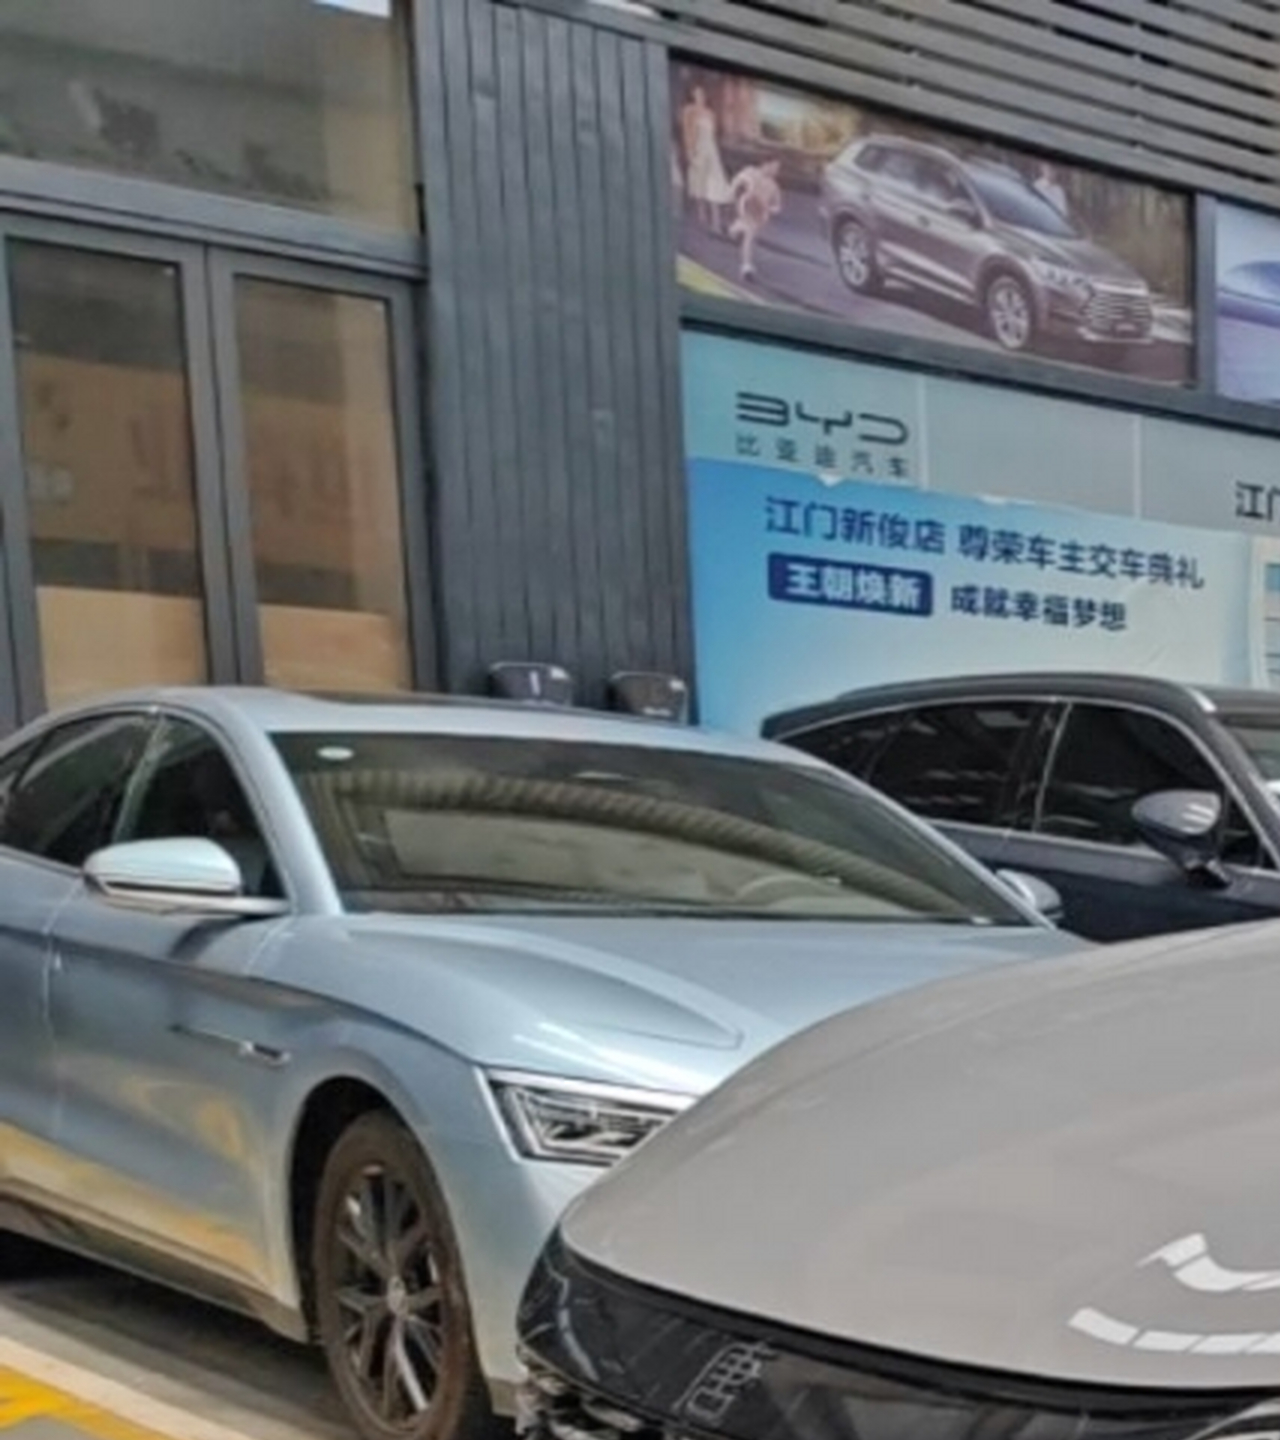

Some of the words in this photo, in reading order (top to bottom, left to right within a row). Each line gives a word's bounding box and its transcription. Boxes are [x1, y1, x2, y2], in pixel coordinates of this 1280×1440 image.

[736, 391, 908, 446] BYD
[766, 496, 944, 553] 江门新俊店
[959, 523, 1204, 590] 尊荣车主交车典礼
[951, 585, 1127, 632] 成就幸福梦想
